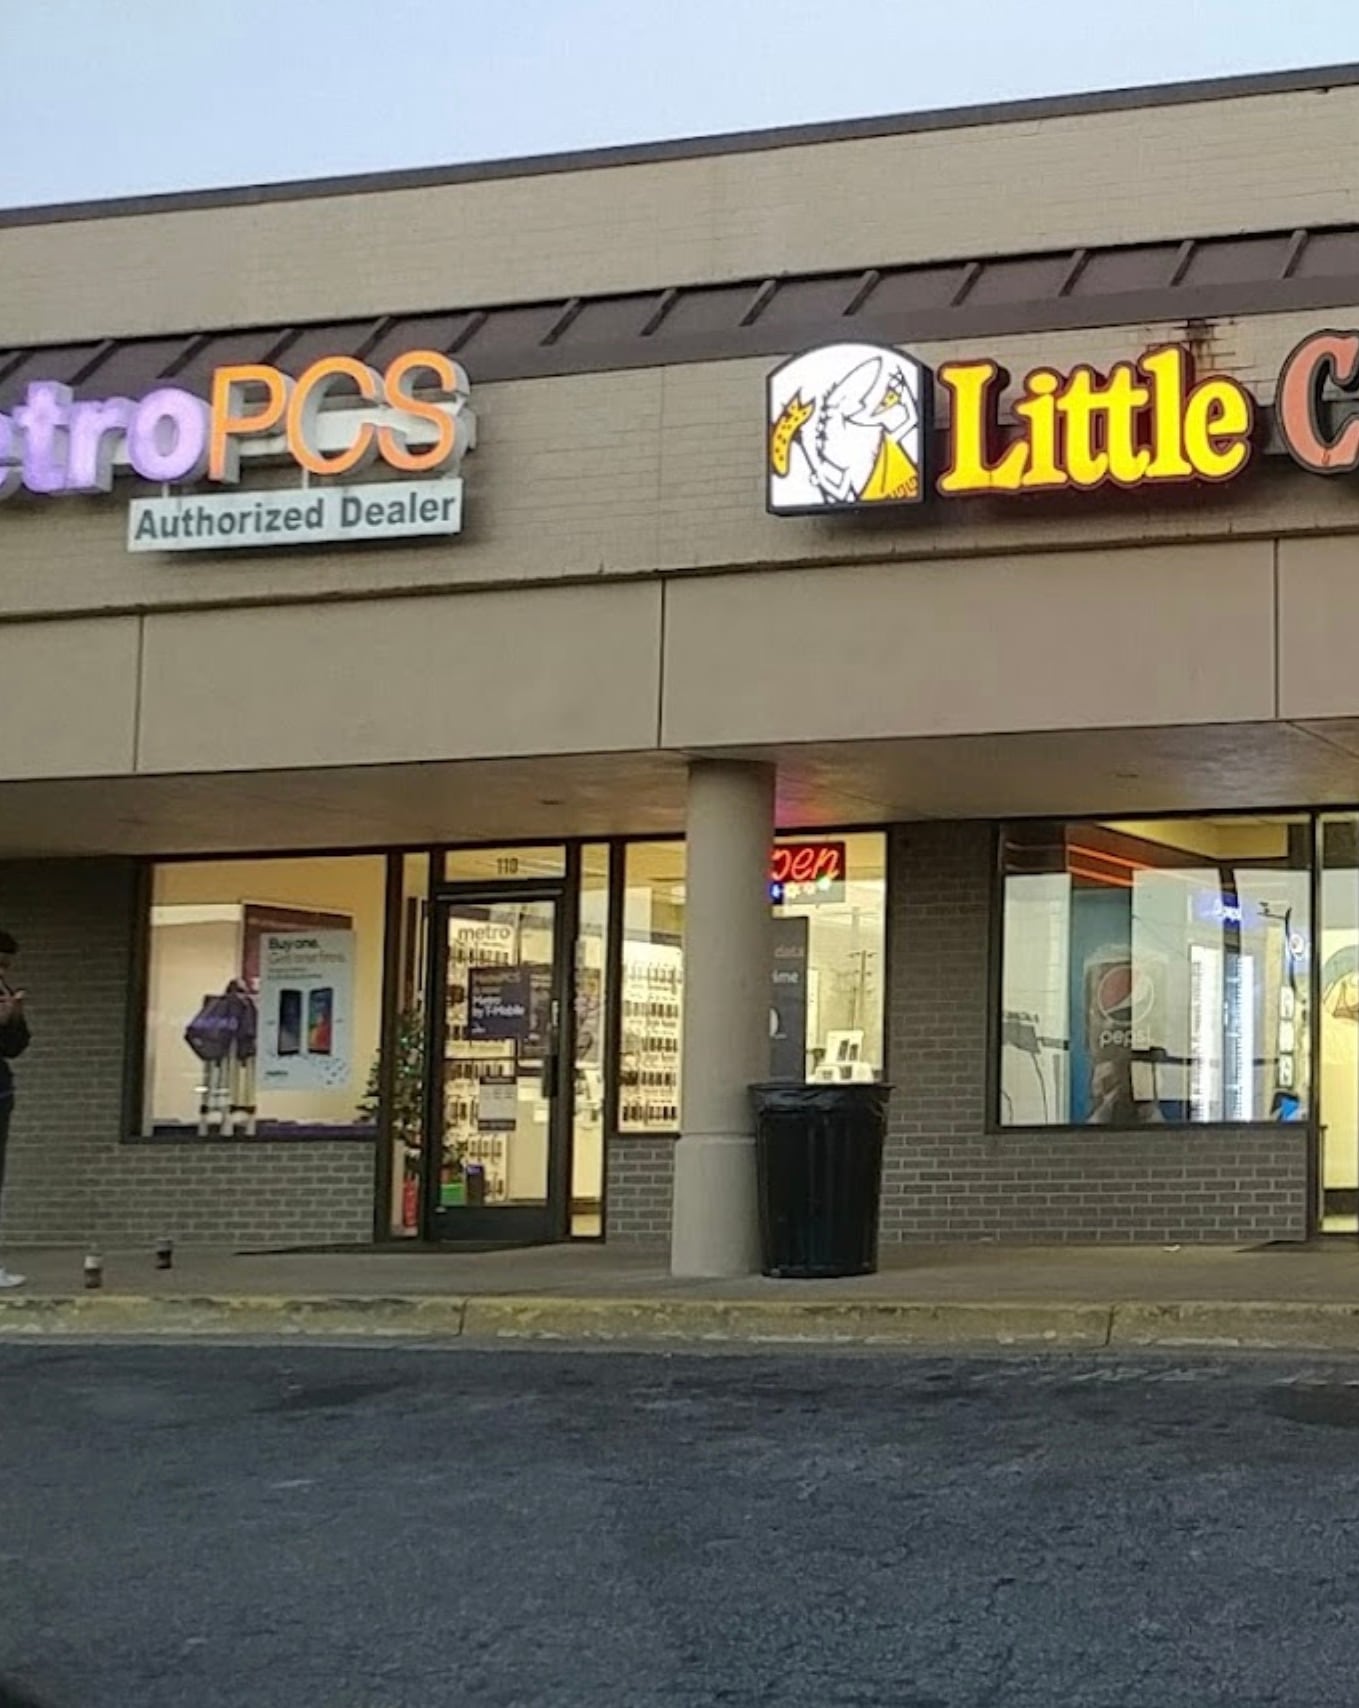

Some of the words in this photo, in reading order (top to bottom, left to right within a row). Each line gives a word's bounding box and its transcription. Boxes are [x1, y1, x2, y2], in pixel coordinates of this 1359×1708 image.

[936, 344, 1256, 493] Little
[134, 496, 325, 542] Authorized
[339, 490, 458, 530] Dealer
[457, 924, 512, 941] metro
[1100, 1025, 1151, 1049] pepsi
